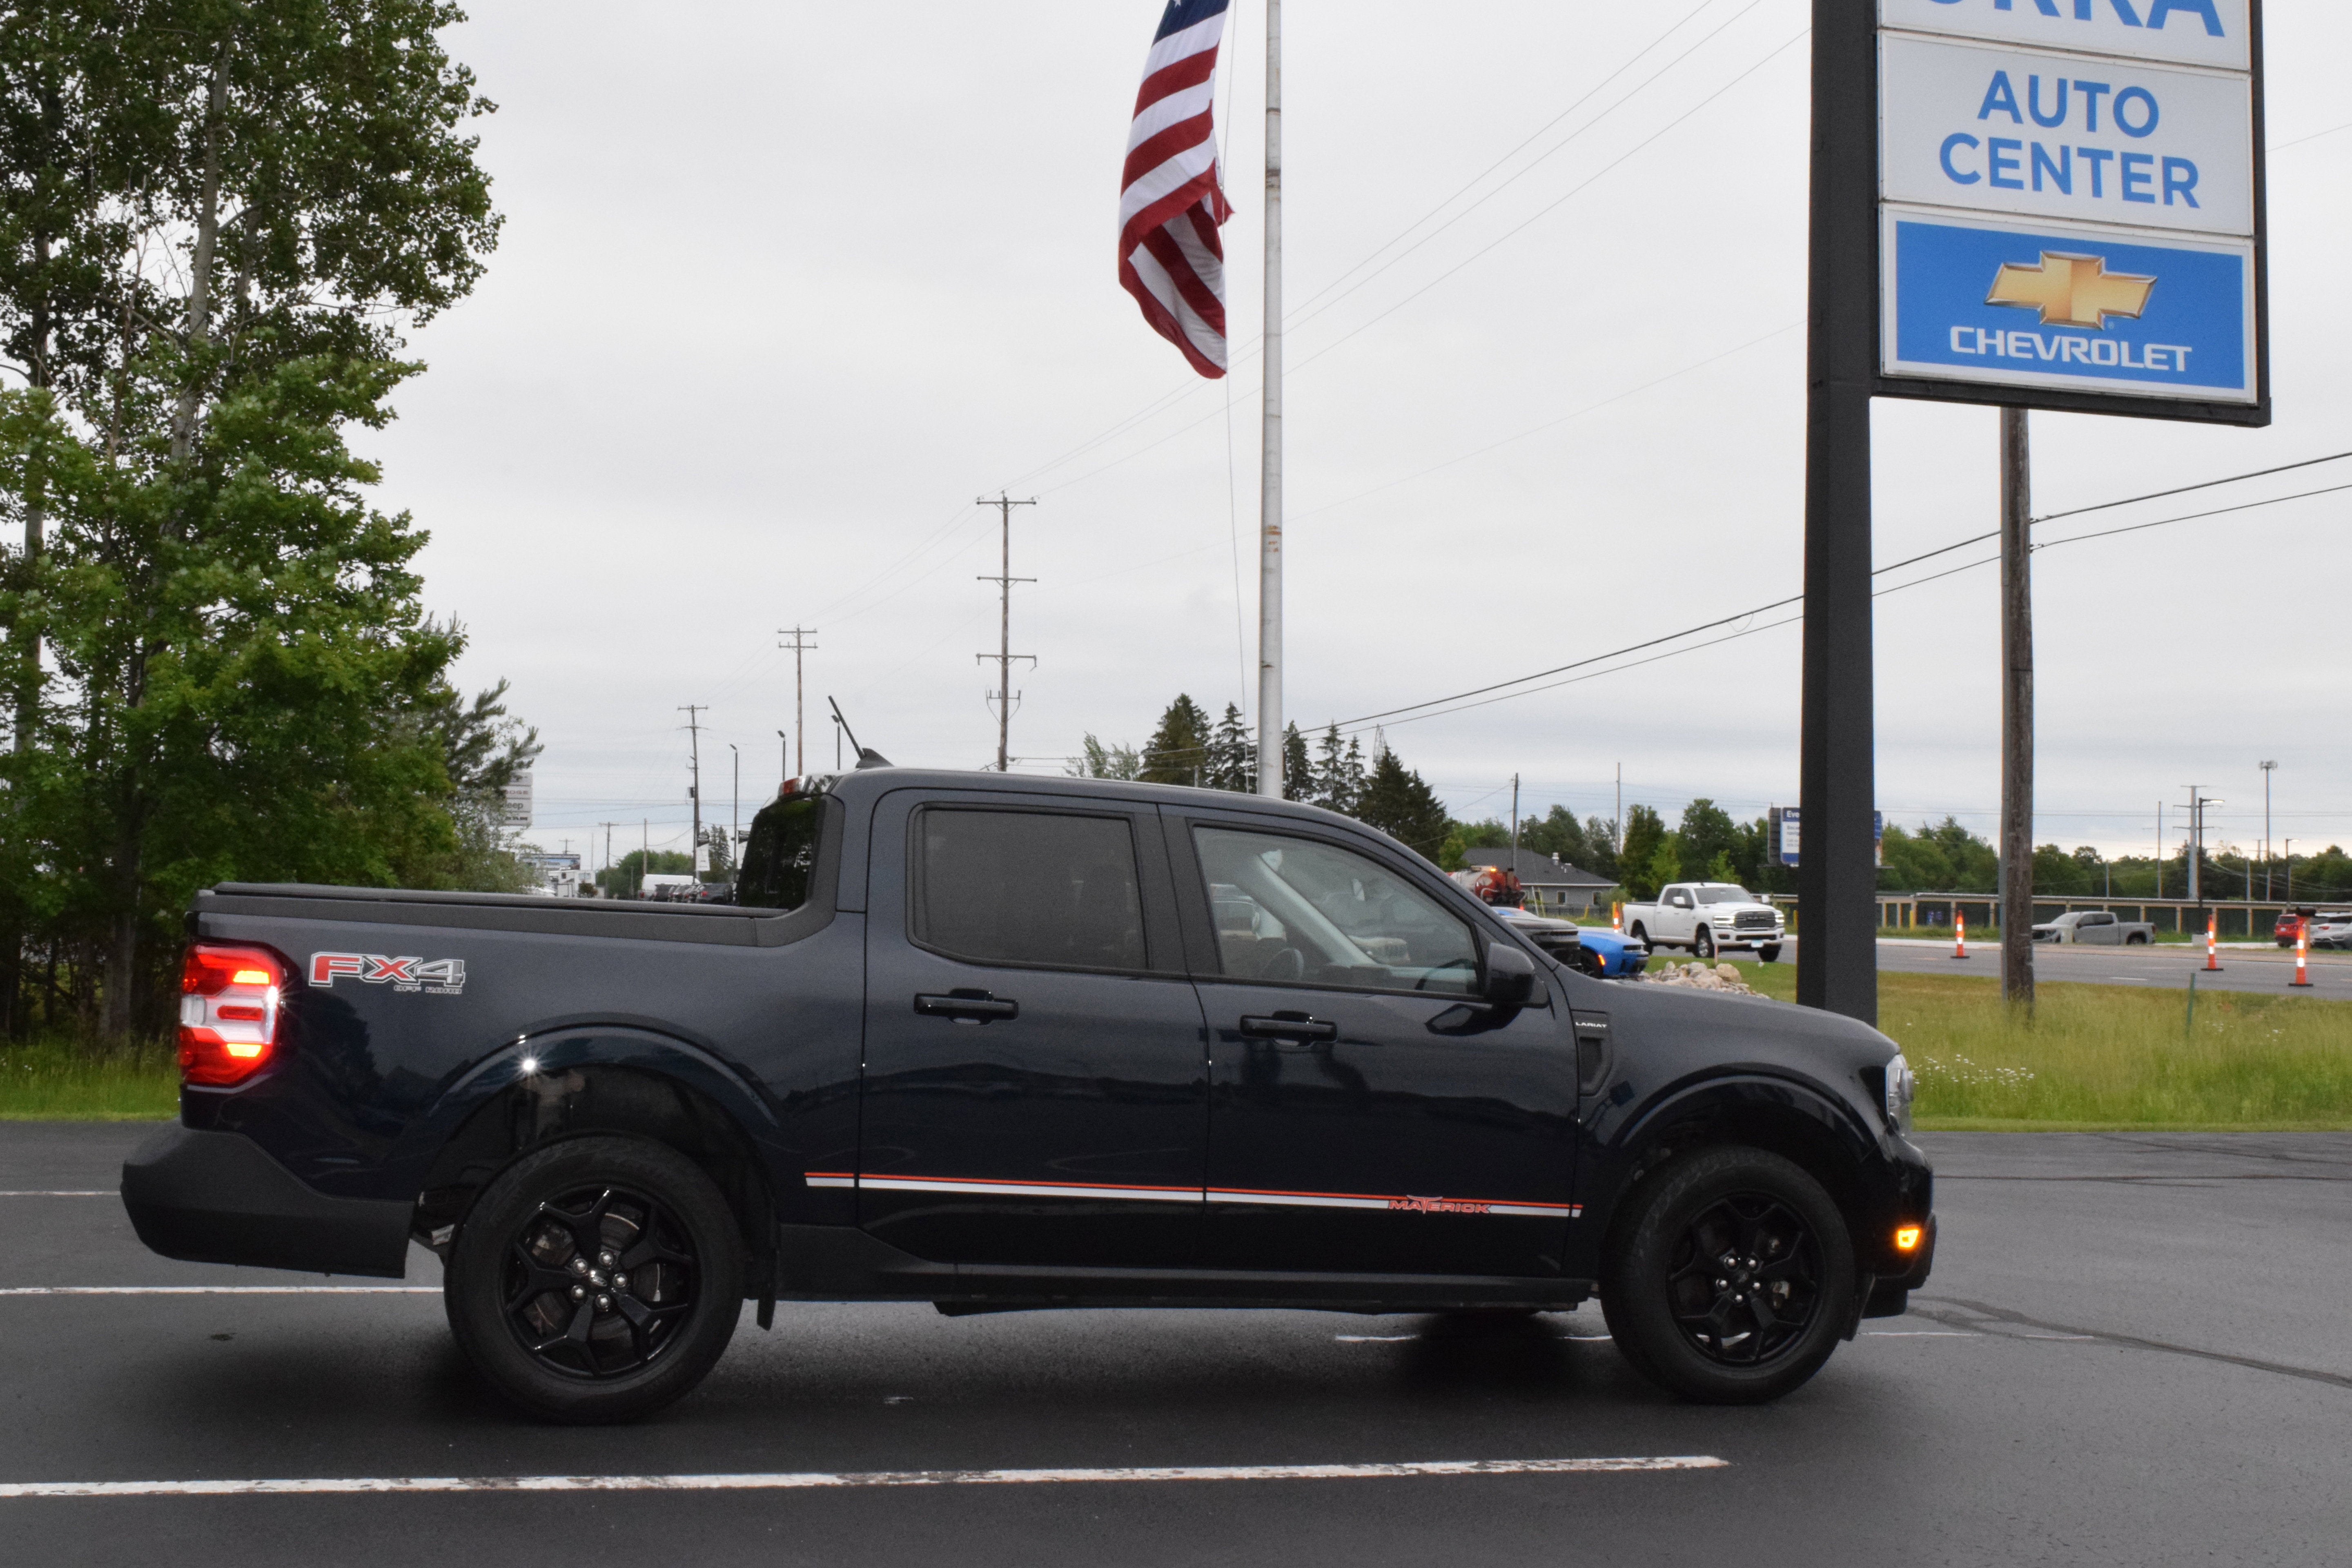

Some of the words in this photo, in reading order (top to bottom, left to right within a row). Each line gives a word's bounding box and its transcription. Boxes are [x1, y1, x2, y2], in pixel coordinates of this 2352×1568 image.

[1978, 70, 2160, 138] AUTO
[1940, 133, 2201, 209] CENTER
[1950, 326, 2193, 372] CHEVROLET
[308, 951, 466, 987] FX4
[1389, 1195, 1490, 1214] MAVERICK
